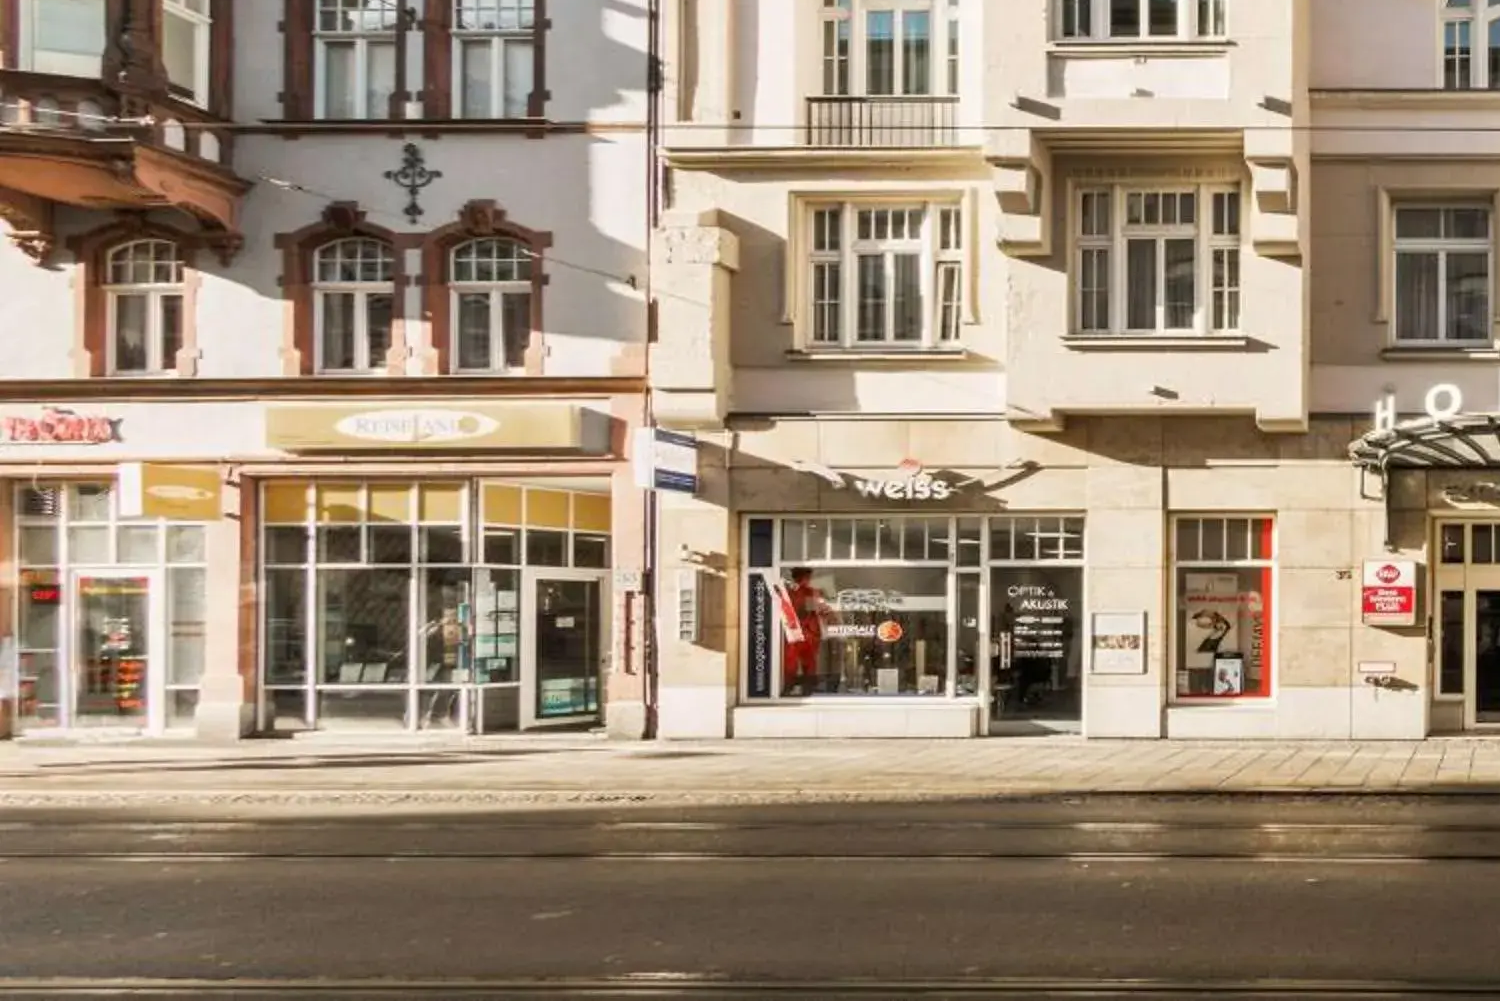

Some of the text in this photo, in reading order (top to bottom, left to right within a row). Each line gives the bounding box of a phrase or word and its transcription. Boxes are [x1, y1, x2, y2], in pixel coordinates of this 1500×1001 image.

[855, 476, 951, 499] weiss
[1008, 586, 1046, 597] OPTIK
[1020, 599, 1068, 610] AKUSTIK
